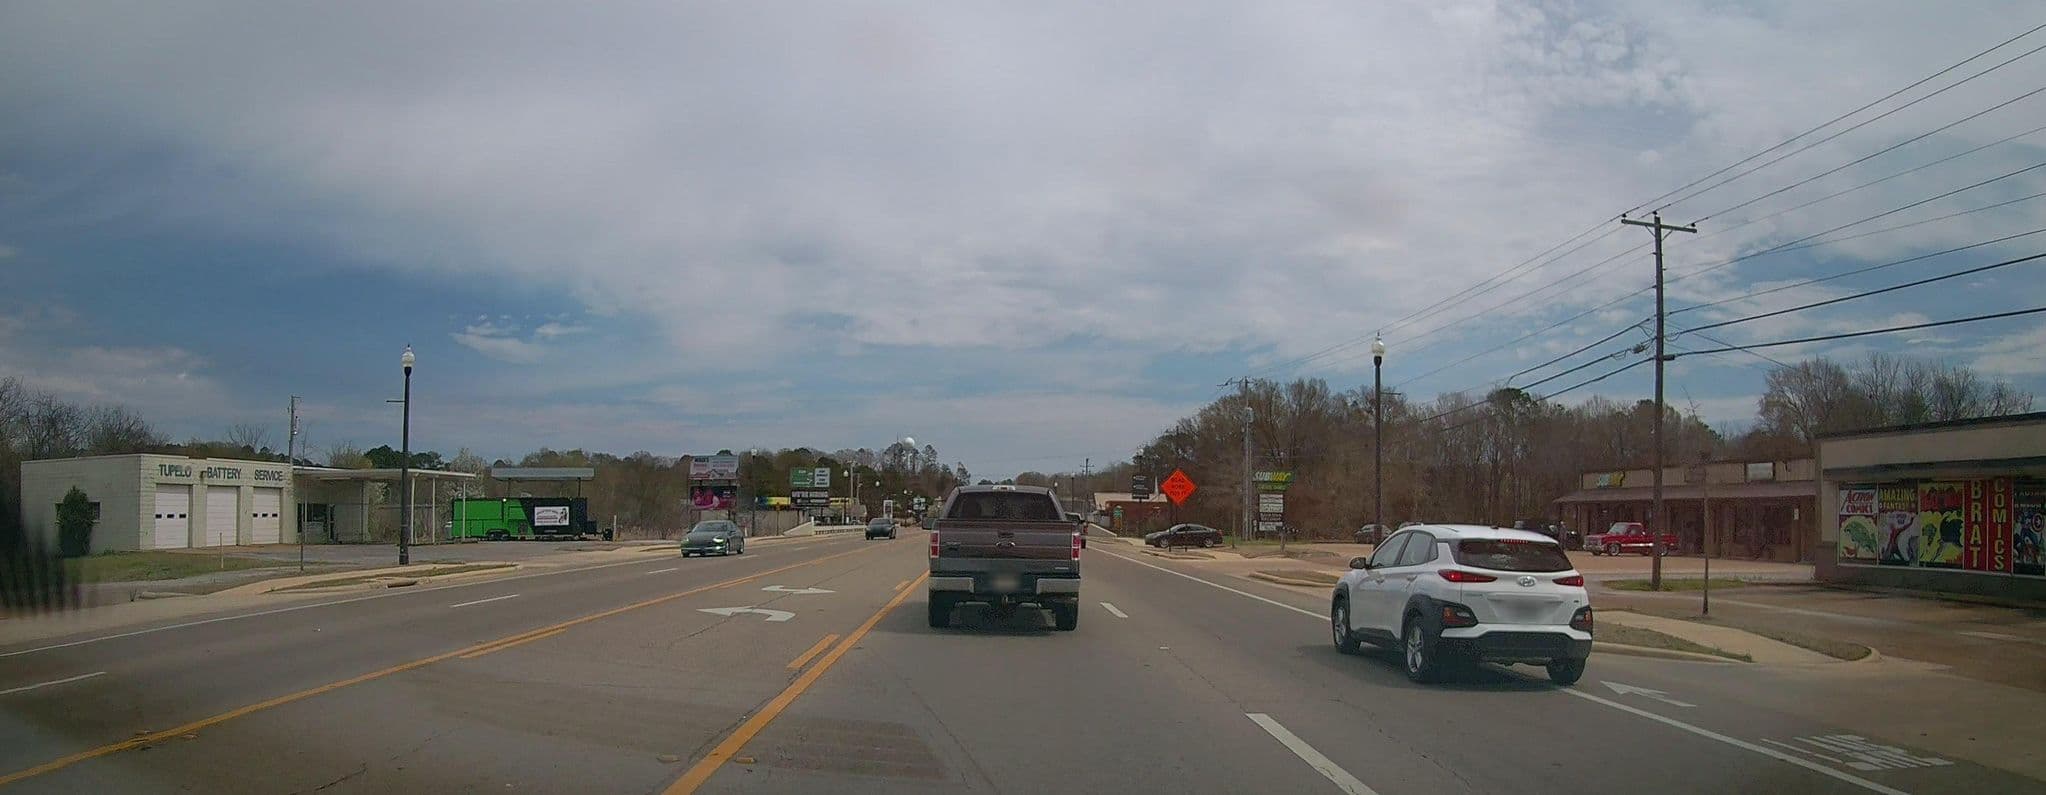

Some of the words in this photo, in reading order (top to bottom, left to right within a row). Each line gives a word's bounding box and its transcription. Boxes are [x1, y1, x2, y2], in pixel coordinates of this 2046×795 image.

[158, 464, 192, 478] TUPELO
[207, 467, 242, 480] BATTERY
[254, 469, 283, 482] SERVICE
[1253, 470, 1291, 481] SUBWAY
[1879, 488, 1916, 502] AMAZING
[1970, 479, 1982, 568] BRAT
[1992, 478, 2006, 570] COMICS
